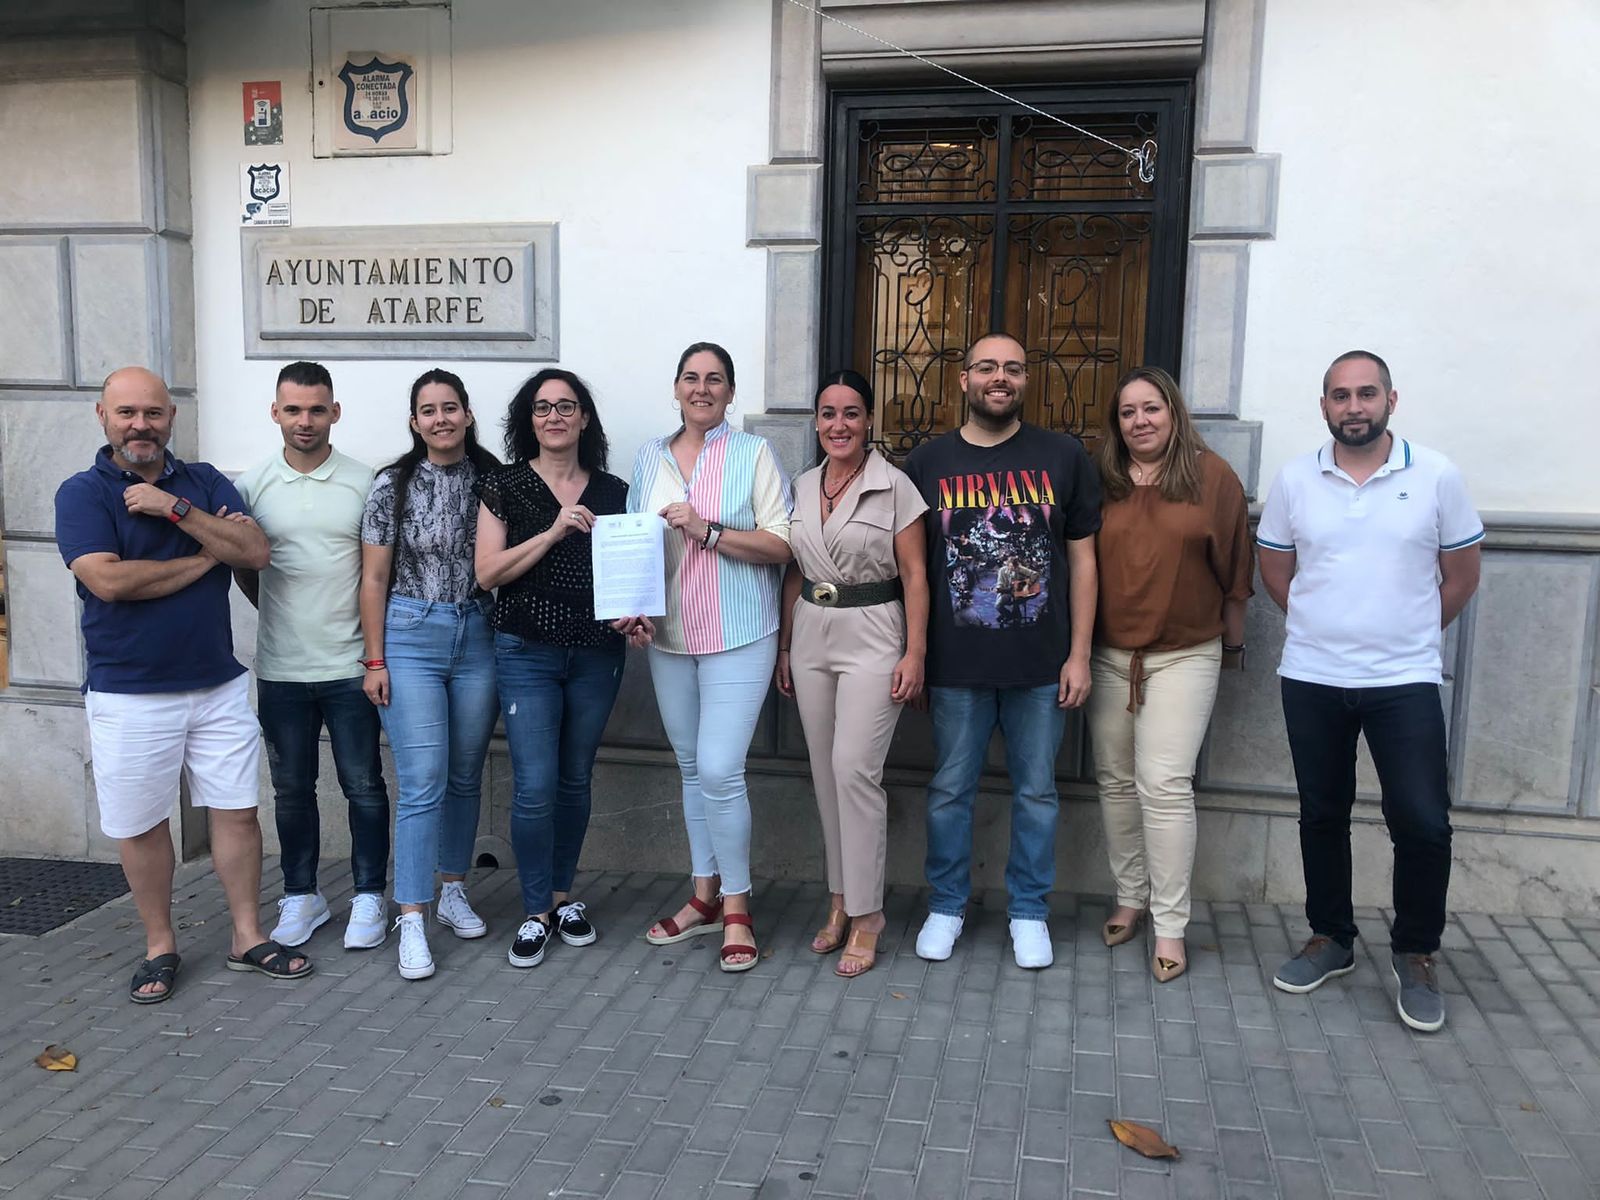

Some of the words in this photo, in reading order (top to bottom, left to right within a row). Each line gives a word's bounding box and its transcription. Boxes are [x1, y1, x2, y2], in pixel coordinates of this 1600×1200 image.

[356, 82, 397, 91] CONECTADA
[353, 107, 398, 119] aacio
[266, 256, 514, 286] AYUNTAMIENTO
[299, 298, 335, 325] DE
[367, 297, 484, 324] ATARFE
[937, 470, 1056, 512] NIRVANA
